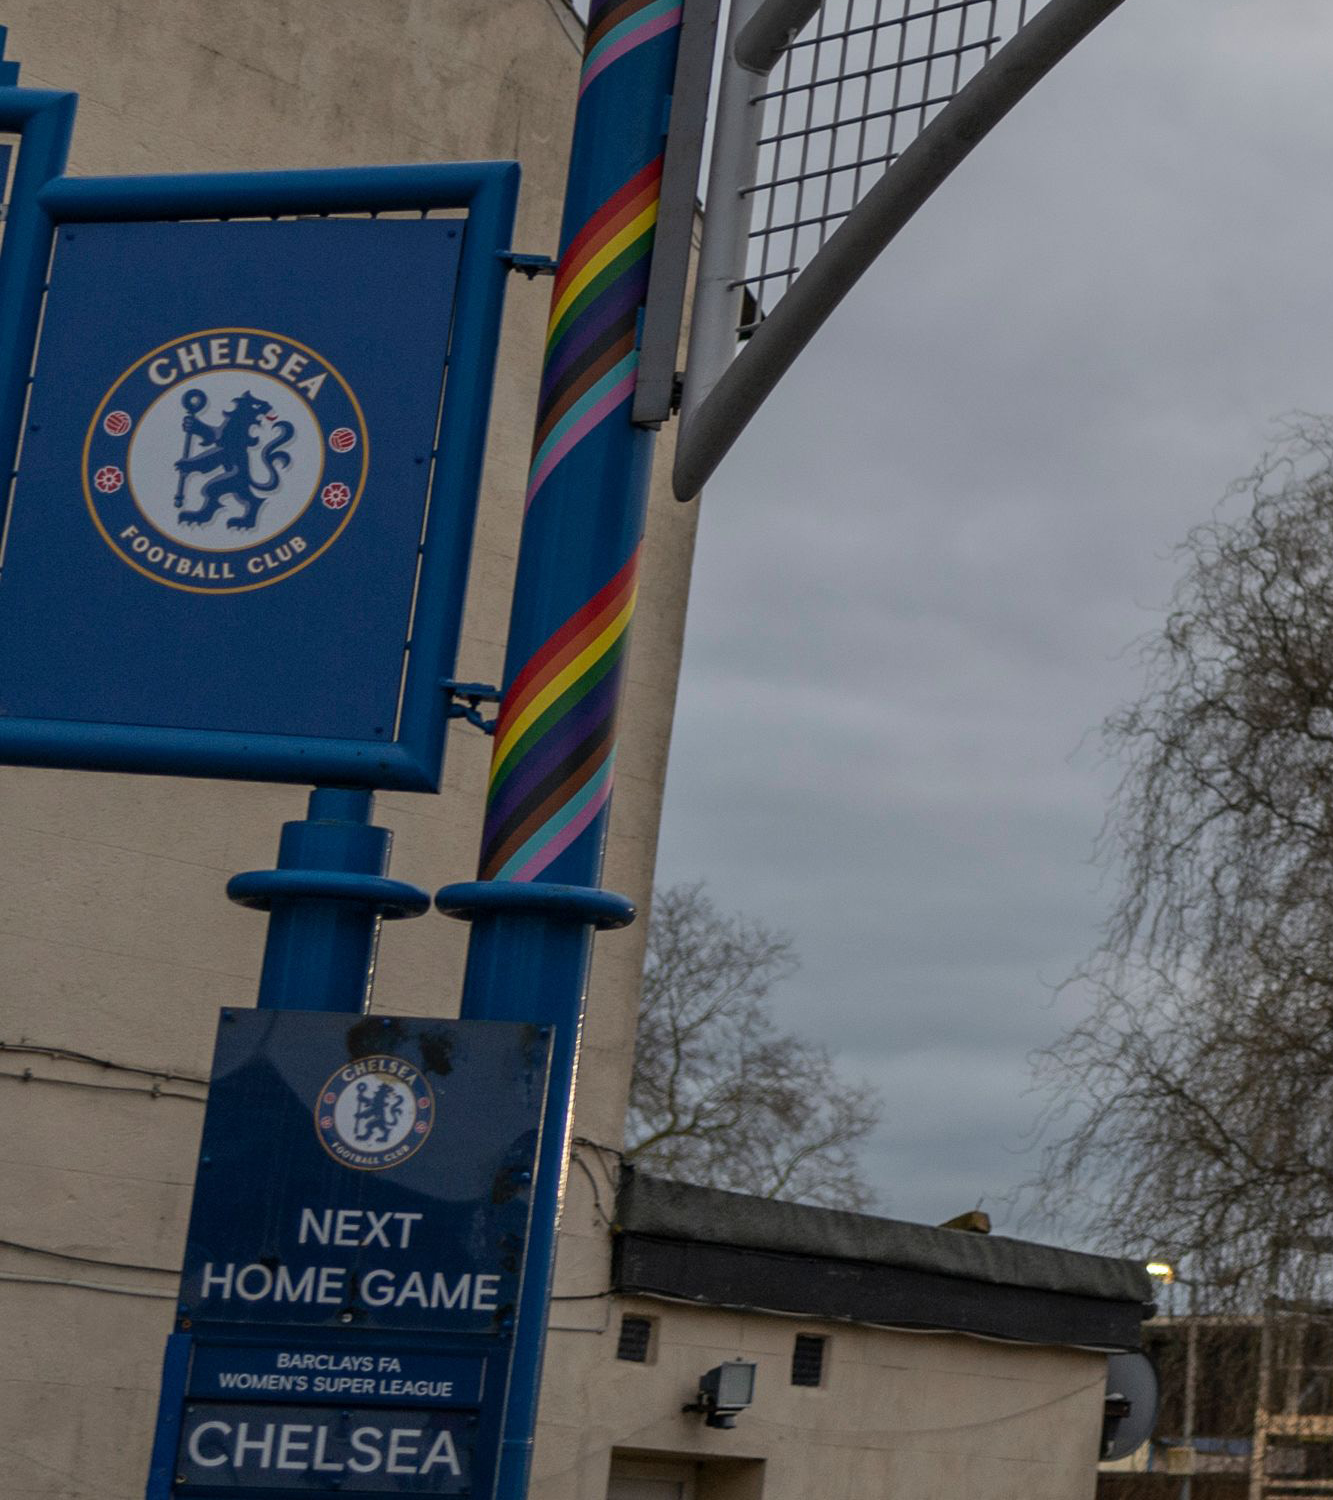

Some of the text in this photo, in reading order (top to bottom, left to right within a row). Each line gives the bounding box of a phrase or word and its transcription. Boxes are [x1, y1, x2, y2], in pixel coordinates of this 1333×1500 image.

[148, 338, 330, 402] CHELSEA
[118, 524, 310, 580] FOOTBALL CLUB
[341, 1057, 418, 1089] CHELSEA
[331, 1140, 412, 1166] FOOTBALL CLUB
[298, 1207, 424, 1250] NEXT
[200, 1261, 501, 1312] HOME GAME
[276, 1352, 402, 1373] BARCLAYS FA
[218, 1372, 453, 1398] WOMEN'S SUPER LEAGUE
[188, 1420, 462, 1477] CHELSEA
